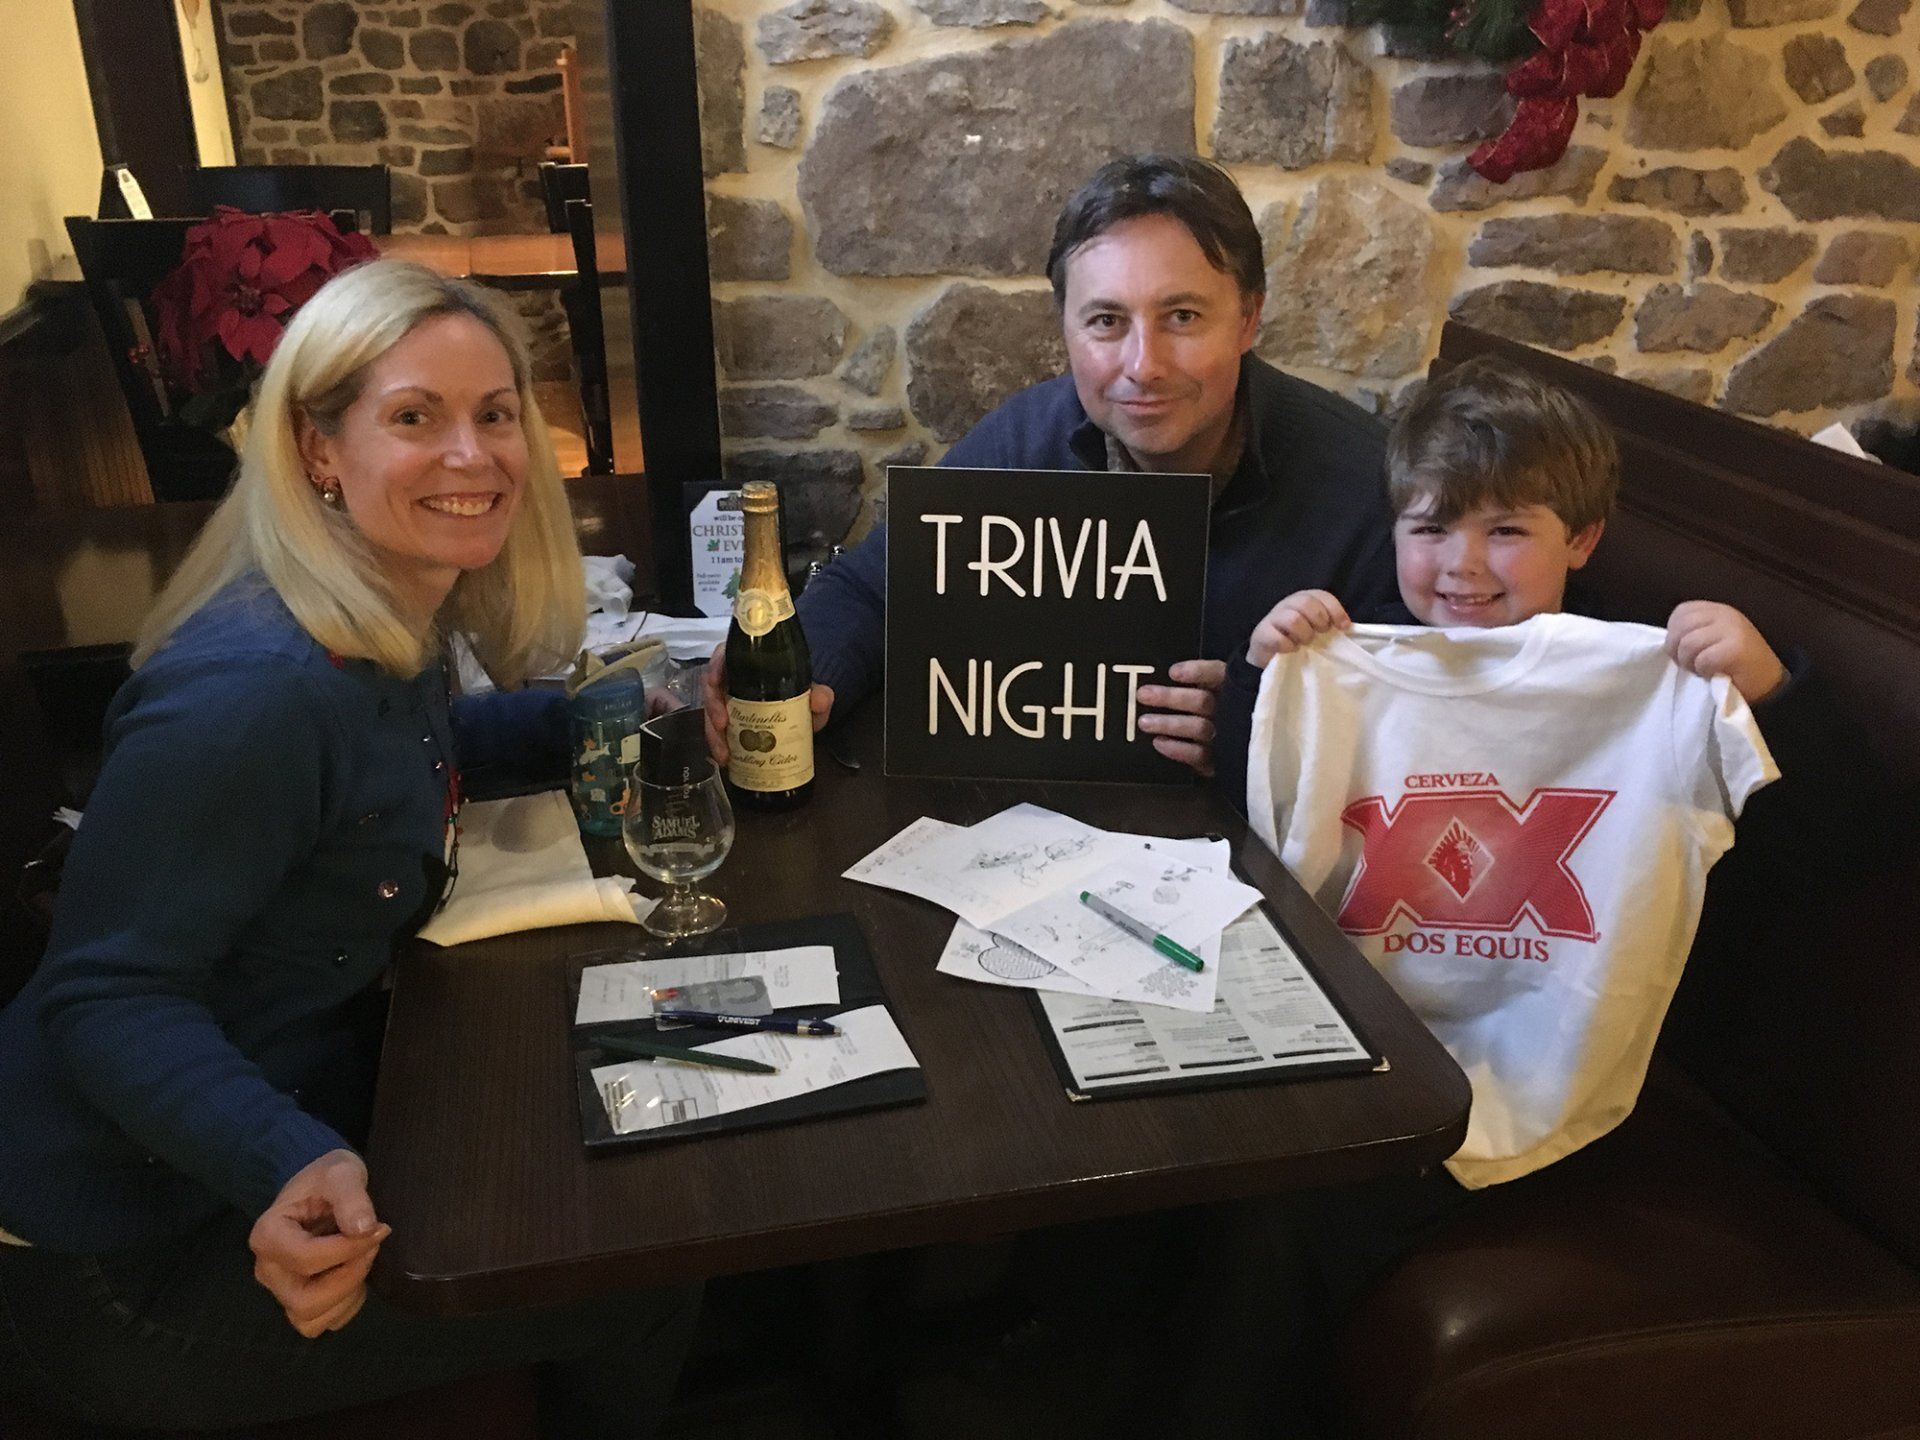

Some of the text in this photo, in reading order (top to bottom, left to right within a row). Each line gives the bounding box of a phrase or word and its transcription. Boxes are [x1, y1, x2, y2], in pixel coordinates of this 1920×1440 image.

[920, 514, 1167, 602] TRIVIA
[929, 657, 1155, 742] NIGHT
[1404, 772, 1499, 789] CERVEZA
[652, 816, 700, 829] SAMUEL
[653, 825, 697, 839] ADAMS
[1383, 932, 1550, 962] DOS EQUIS
[725, 1016, 761, 1026] UNIVEST
